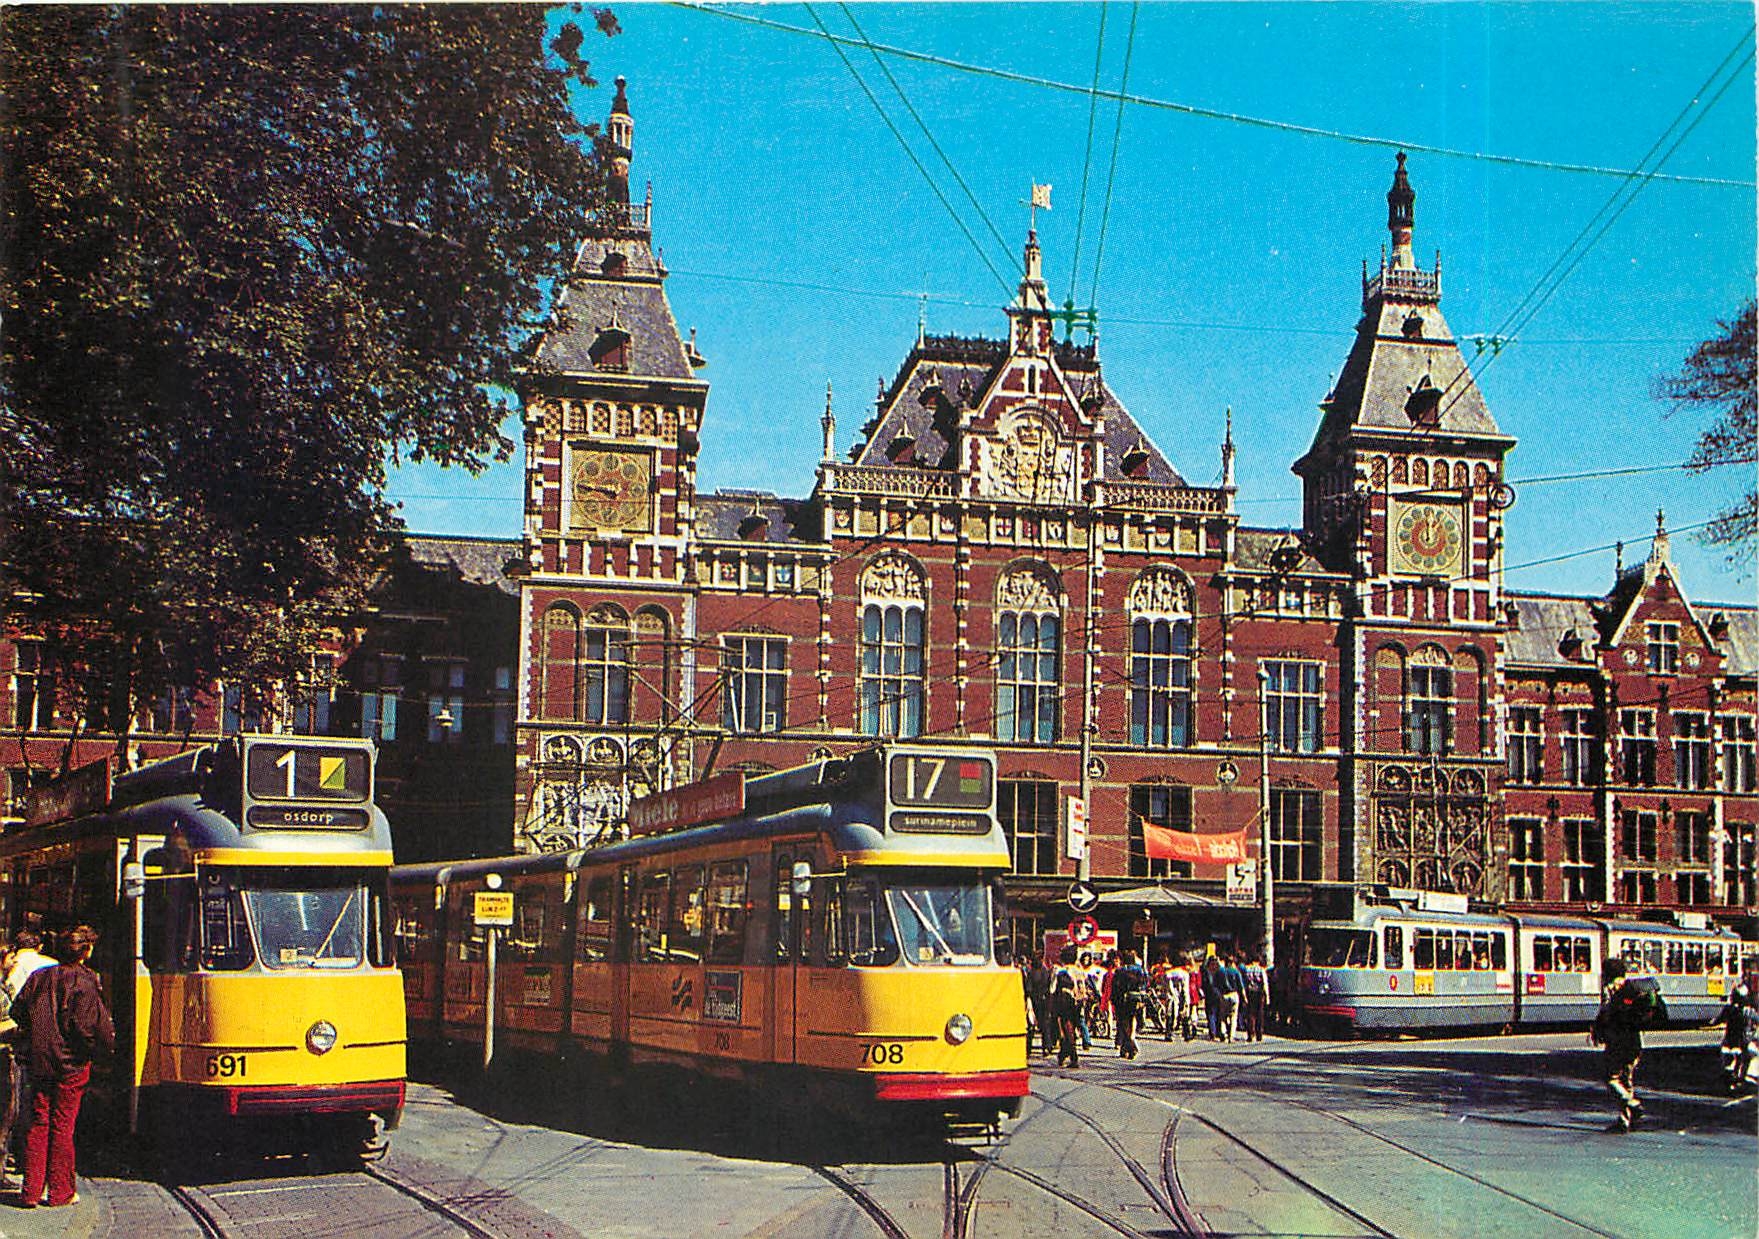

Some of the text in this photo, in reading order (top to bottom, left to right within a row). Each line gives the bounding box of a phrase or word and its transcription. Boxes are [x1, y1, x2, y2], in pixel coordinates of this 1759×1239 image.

[275, 749, 297, 798] 1
[907, 758, 946, 800] 17
[284, 812, 334, 824] osdorp
[904, 817, 978, 829] surinameplein
[859, 1043, 904, 1064] 708
[207, 1055, 246, 1077] 691
